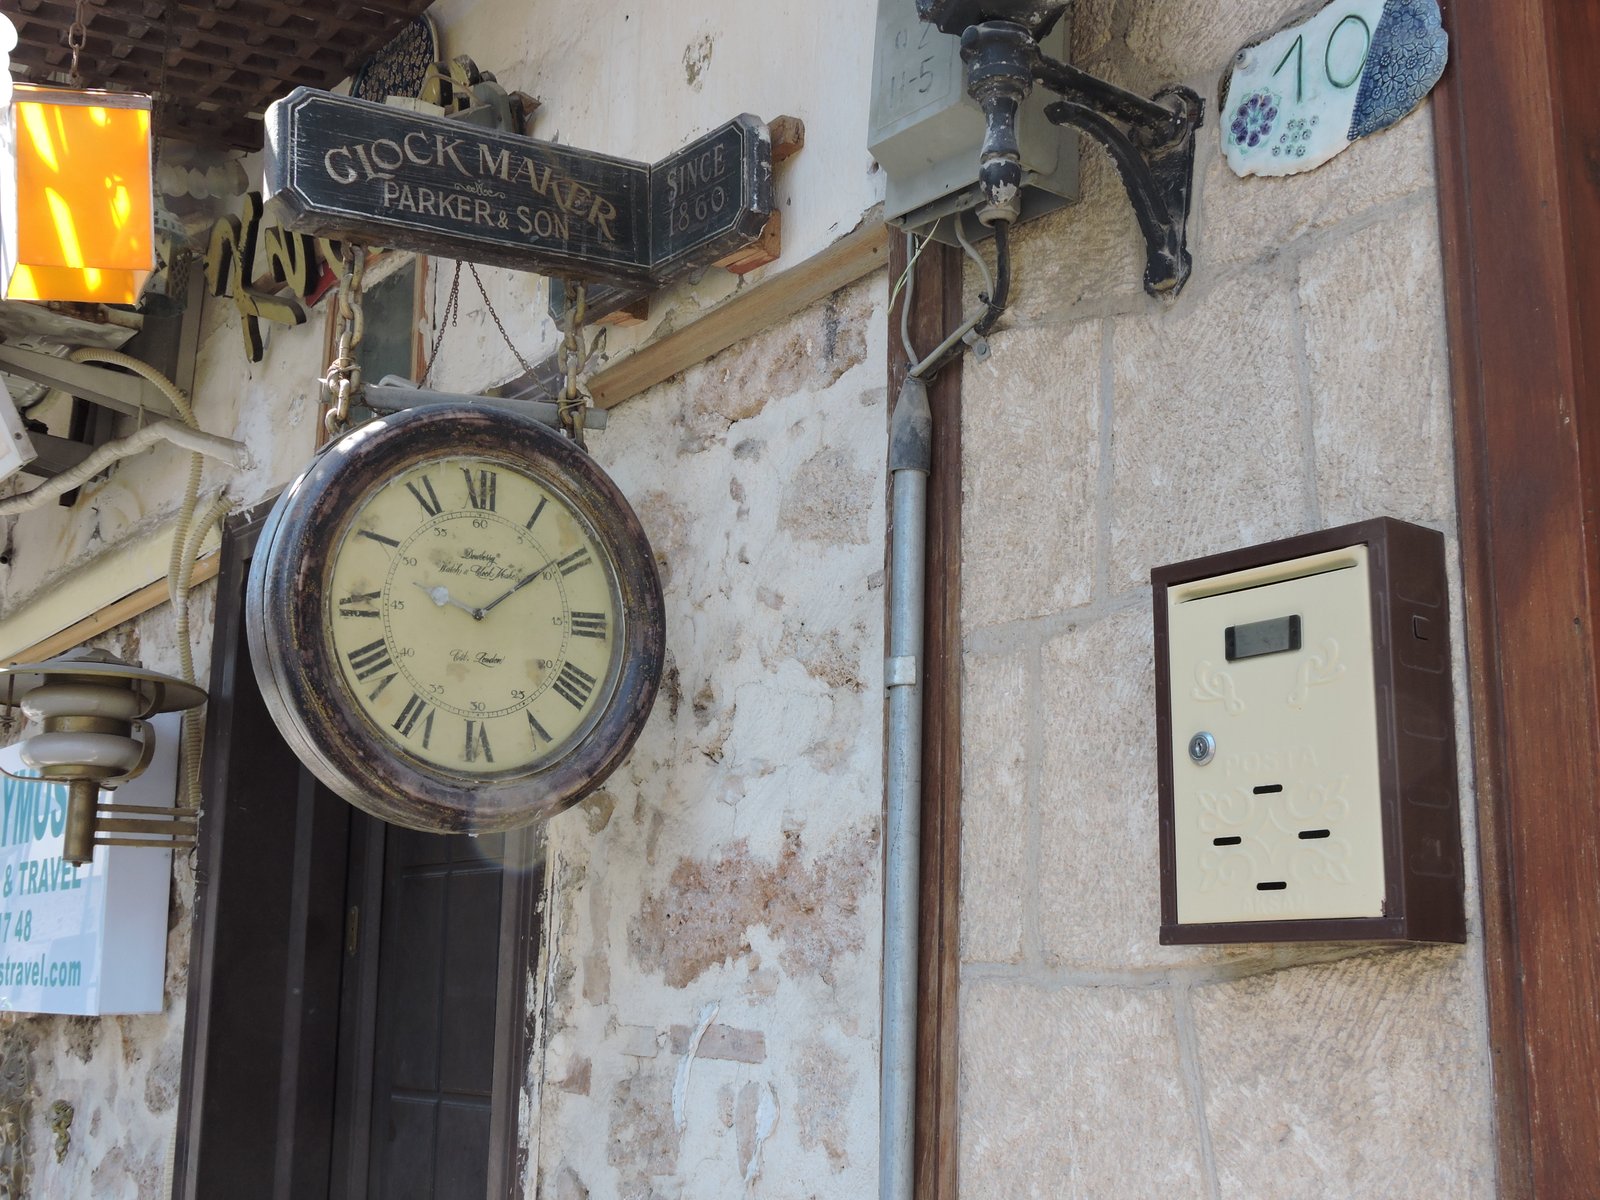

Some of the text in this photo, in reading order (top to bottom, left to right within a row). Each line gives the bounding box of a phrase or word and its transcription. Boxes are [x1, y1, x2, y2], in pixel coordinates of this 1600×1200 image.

[1271, 14, 1371, 104] 10
[477, 143, 617, 242] MAKER
[667, 142, 725, 203] SINCE
[383, 180, 570, 240] PARKER & SON
[669, 185, 725, 237] 1860
[460, 467, 497, 512] XII
[472, 518, 489, 529] 60
[402, 556, 418, 567] 50
[390, 600, 405, 611] 45
[399, 647, 416, 658] 40
[510, 689, 527, 700] 25
[3, 857, 82, 898] & TRAVEL
[15, 908, 33, 943] 48
